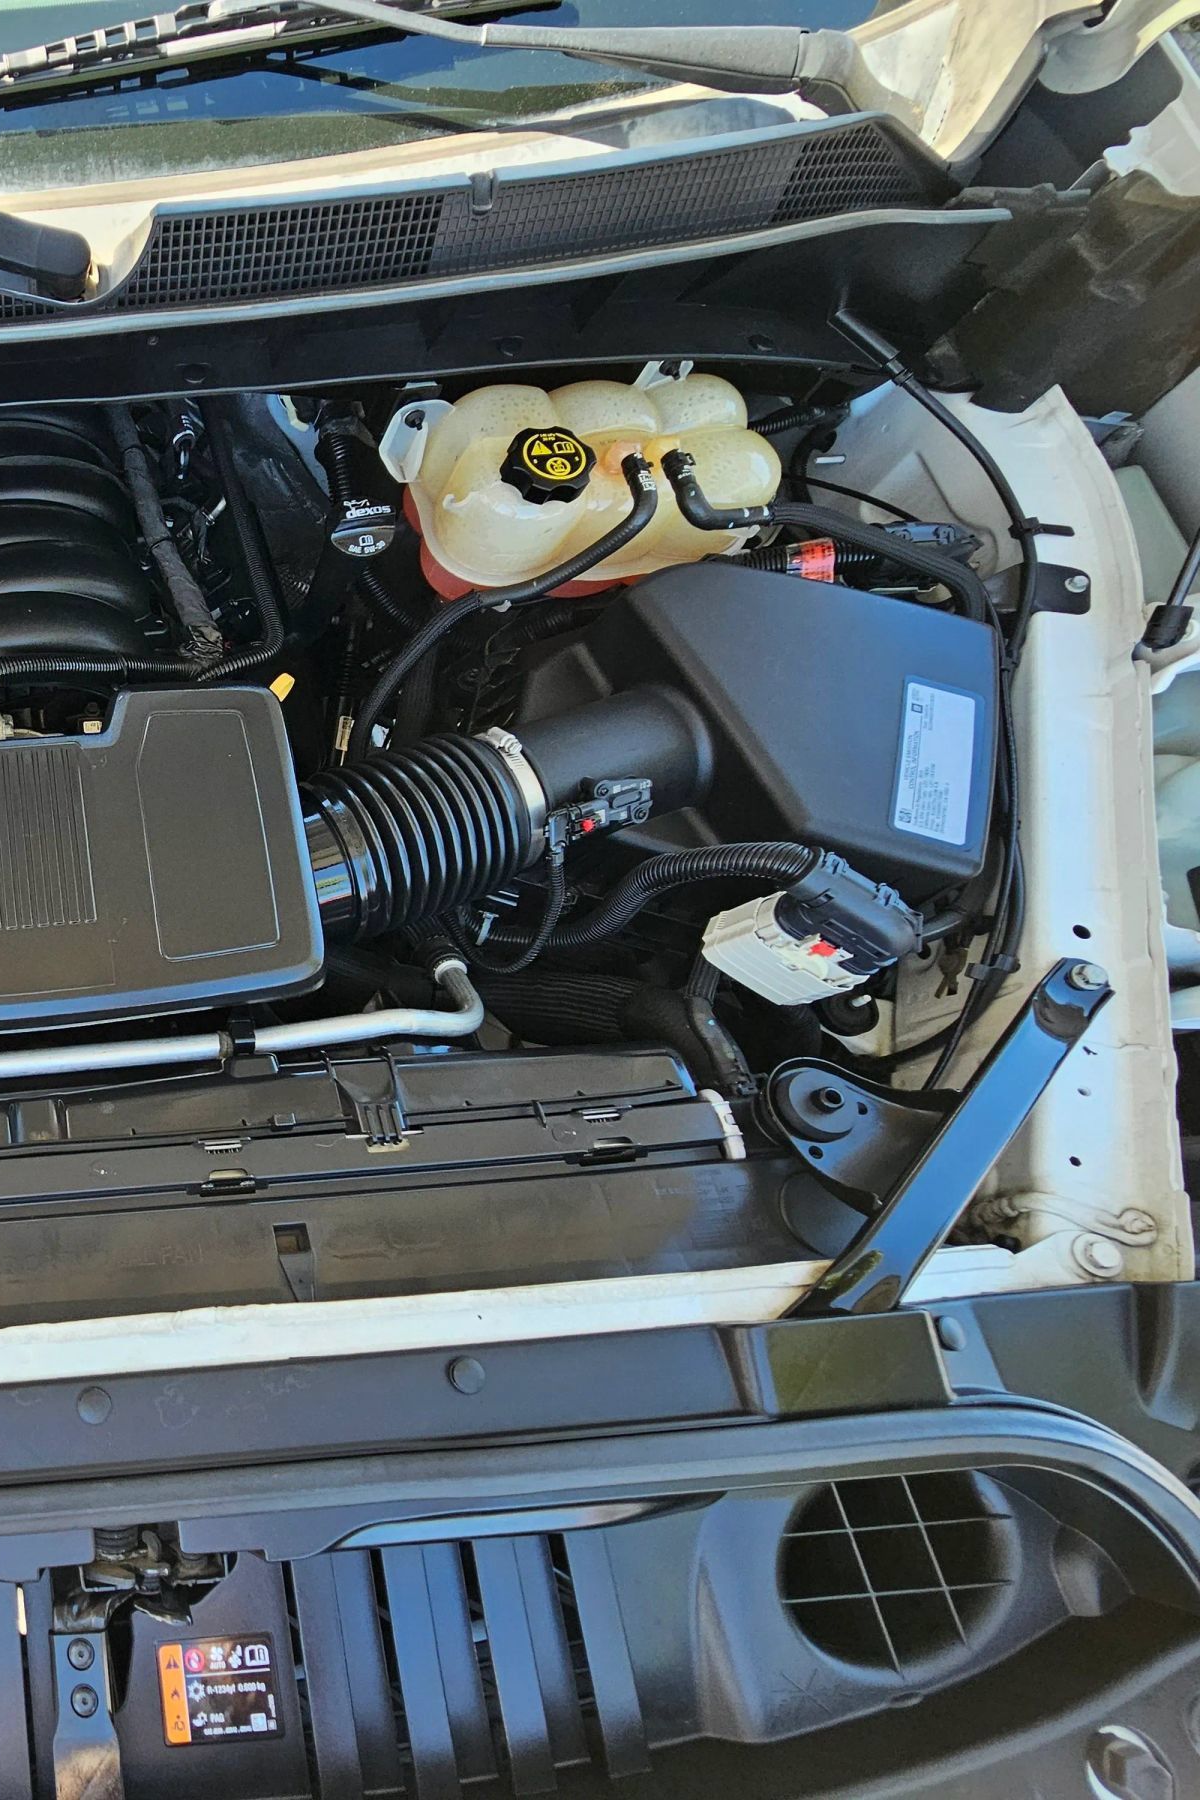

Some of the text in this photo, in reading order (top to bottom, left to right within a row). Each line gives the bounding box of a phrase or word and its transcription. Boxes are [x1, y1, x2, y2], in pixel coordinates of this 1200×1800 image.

[346, 505, 391, 519] dexos
[348, 544, 362, 553] SAE
[210, 1661, 226, 1670] AUTO
